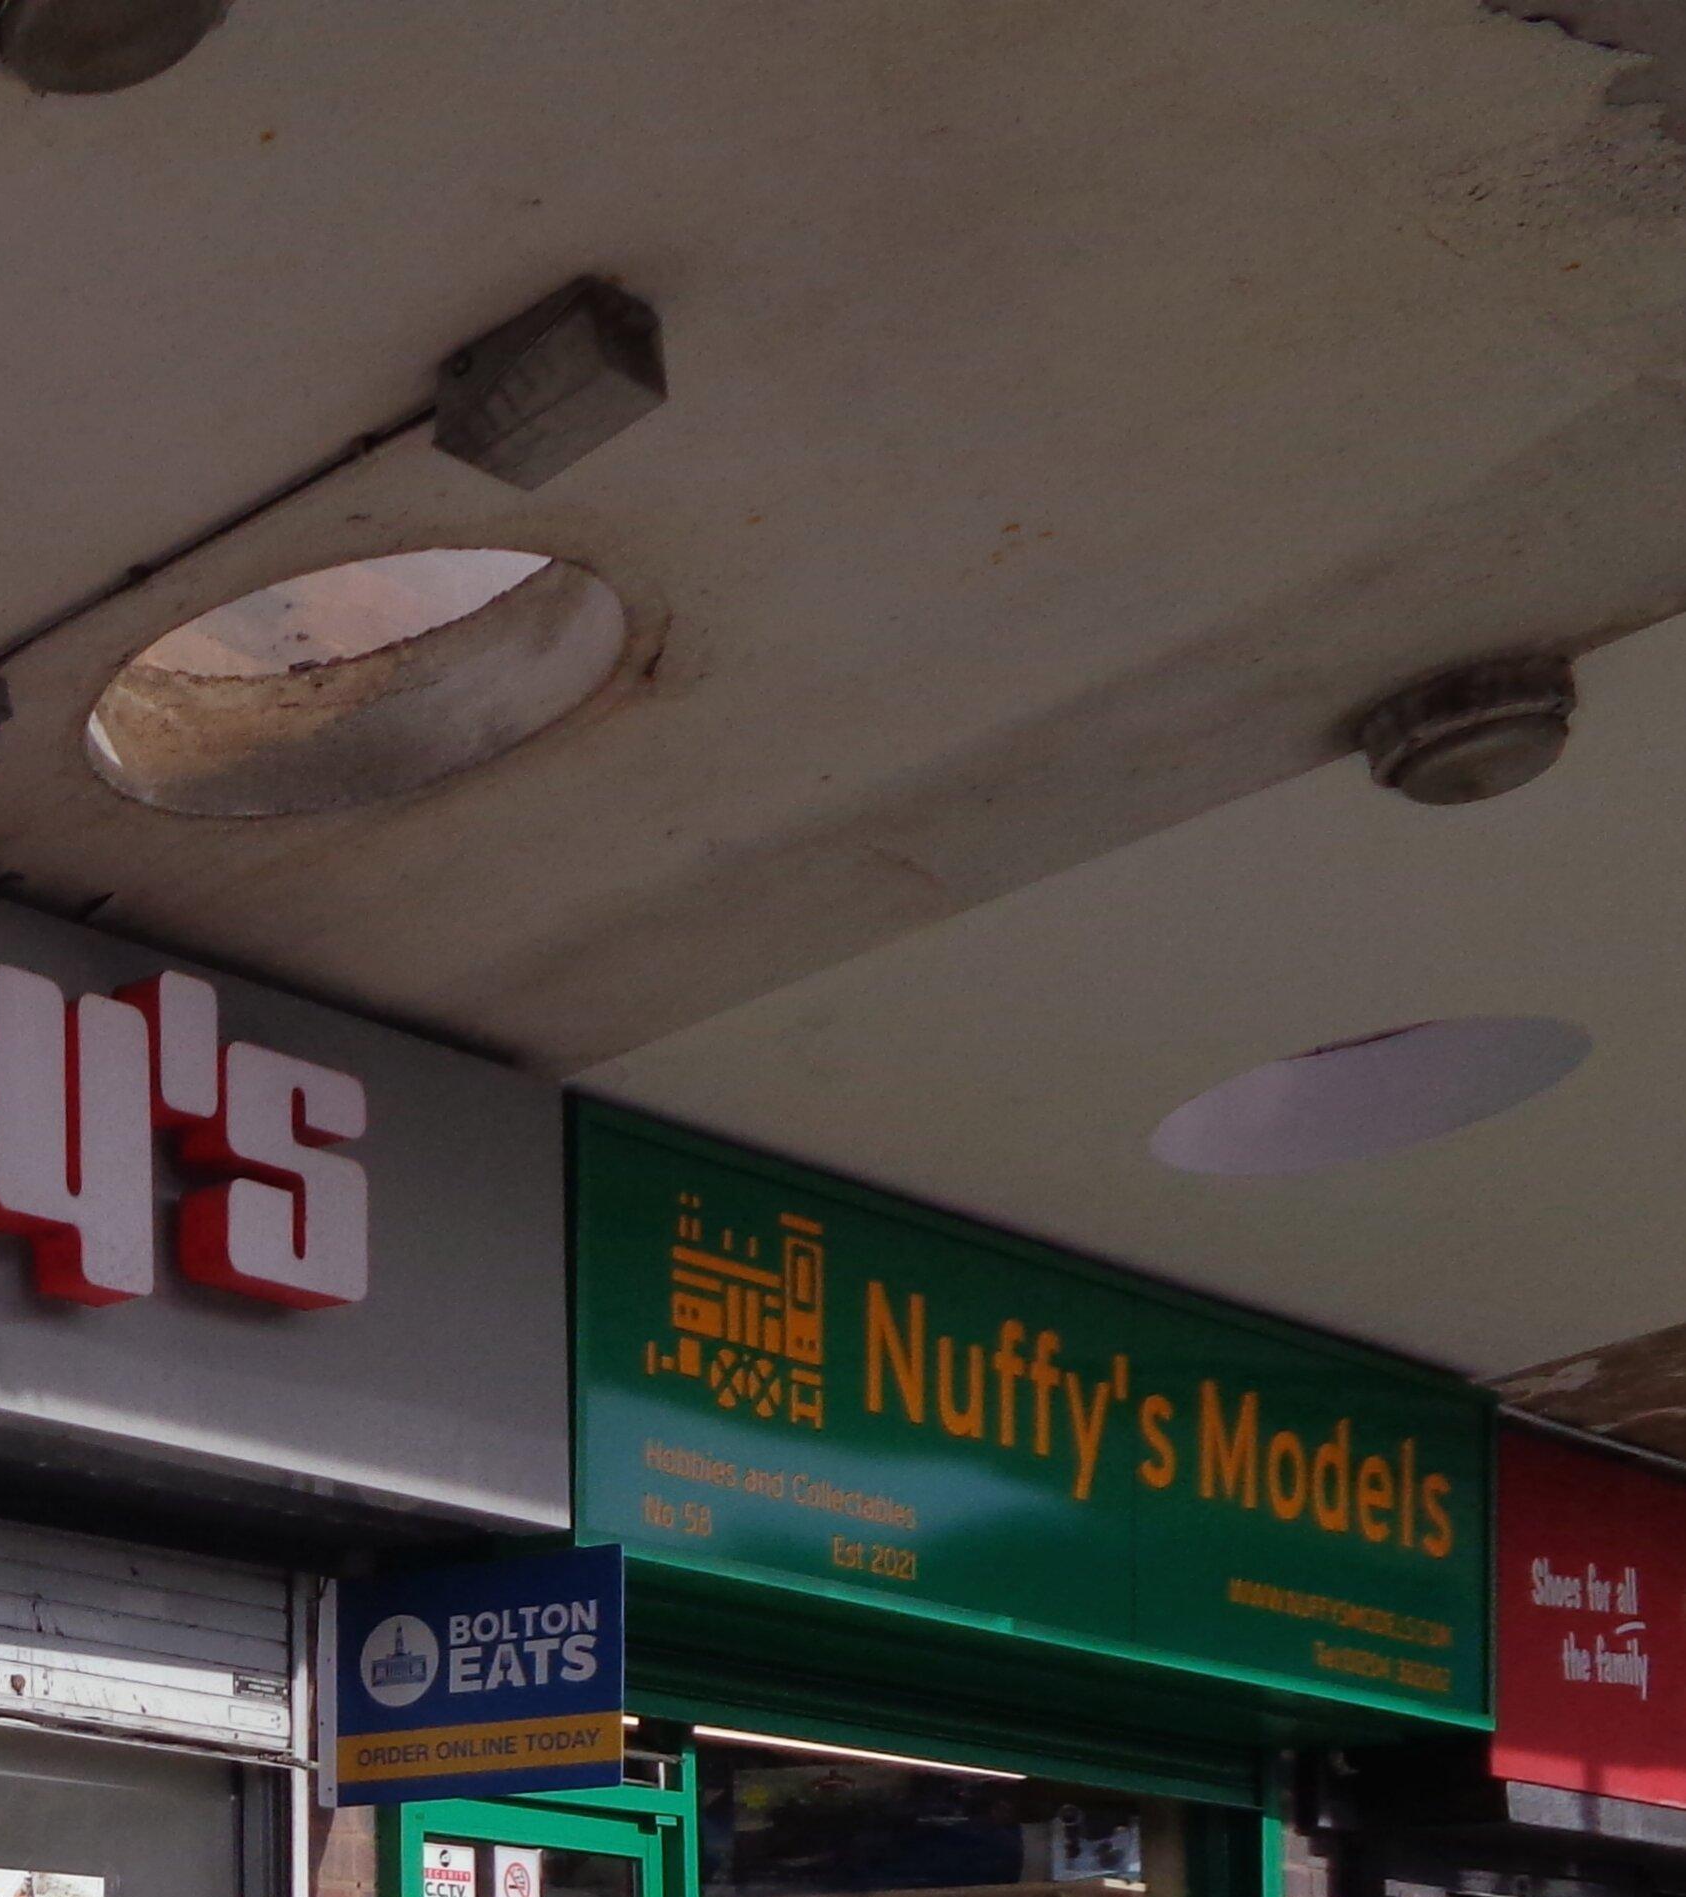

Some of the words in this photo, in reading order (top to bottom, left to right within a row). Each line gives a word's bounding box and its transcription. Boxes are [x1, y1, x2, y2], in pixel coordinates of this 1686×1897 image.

[864, 1278, 1178, 1502] Nuffy's
[1197, 1378, 1454, 1560] Models
[644, 1438, 737, 1488] Hobbies
[744, 1467, 784, 1498] and
[792, 1473, 918, 1531] Collectables
[833, 1534, 864, 1570] Est
[871, 1543, 918, 1581] 2021
[1532, 1557, 1582, 1609] Shoes
[1587, 1563, 1611, 1612] for
[1617, 1566, 1638, 1615] all
[448, 1599, 598, 1646] BOLTON
[448, 1634, 597, 1694] EATS
[1563, 1631, 1591, 1681] the
[1595, 1634, 1648, 1700] family
[357, 1737, 428, 1768] ORDER
[437, 1735, 517, 1760] ONLINE
[527, 1727, 601, 1752] TODAY
